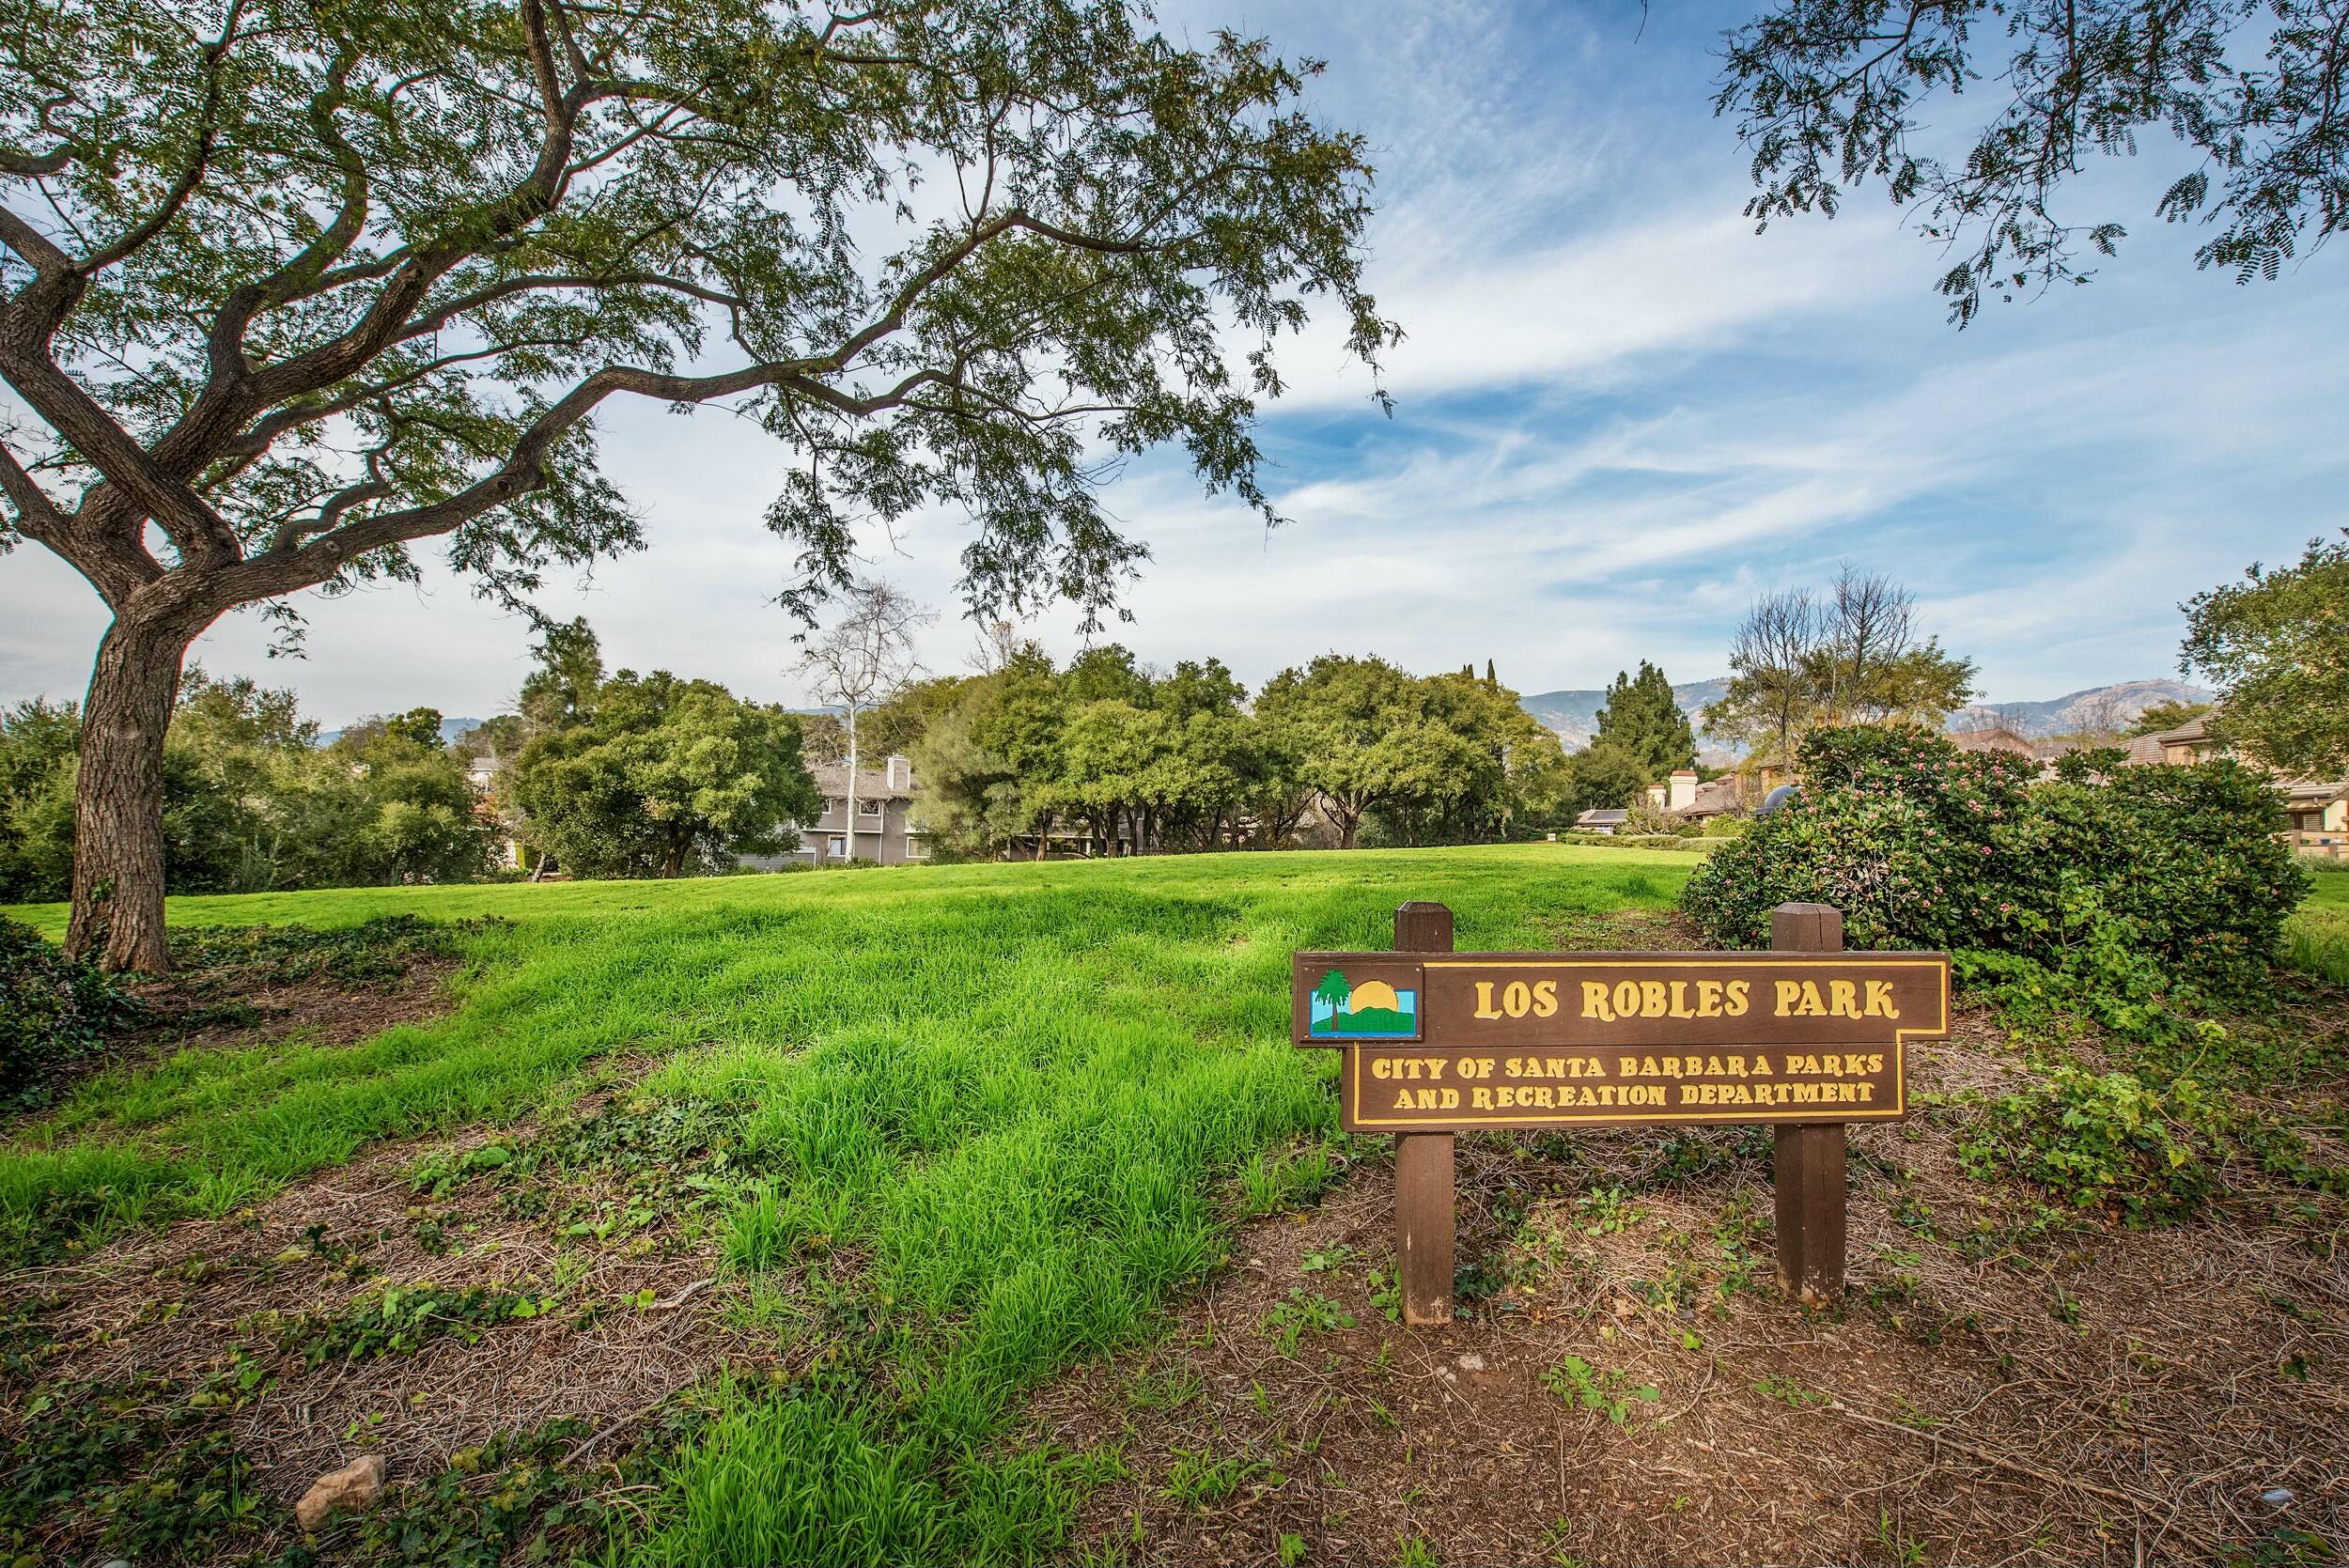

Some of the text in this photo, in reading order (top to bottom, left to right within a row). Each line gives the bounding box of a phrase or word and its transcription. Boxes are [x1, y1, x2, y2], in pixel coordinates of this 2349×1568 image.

[1473, 979, 1901, 1023] LOS ROBLES PARK
[1371, 1053, 1884, 1080] CITY OF SANTA BARBARA PARKS
[1392, 1081, 1875, 1111] AND RECREATION DEPARTMENT
